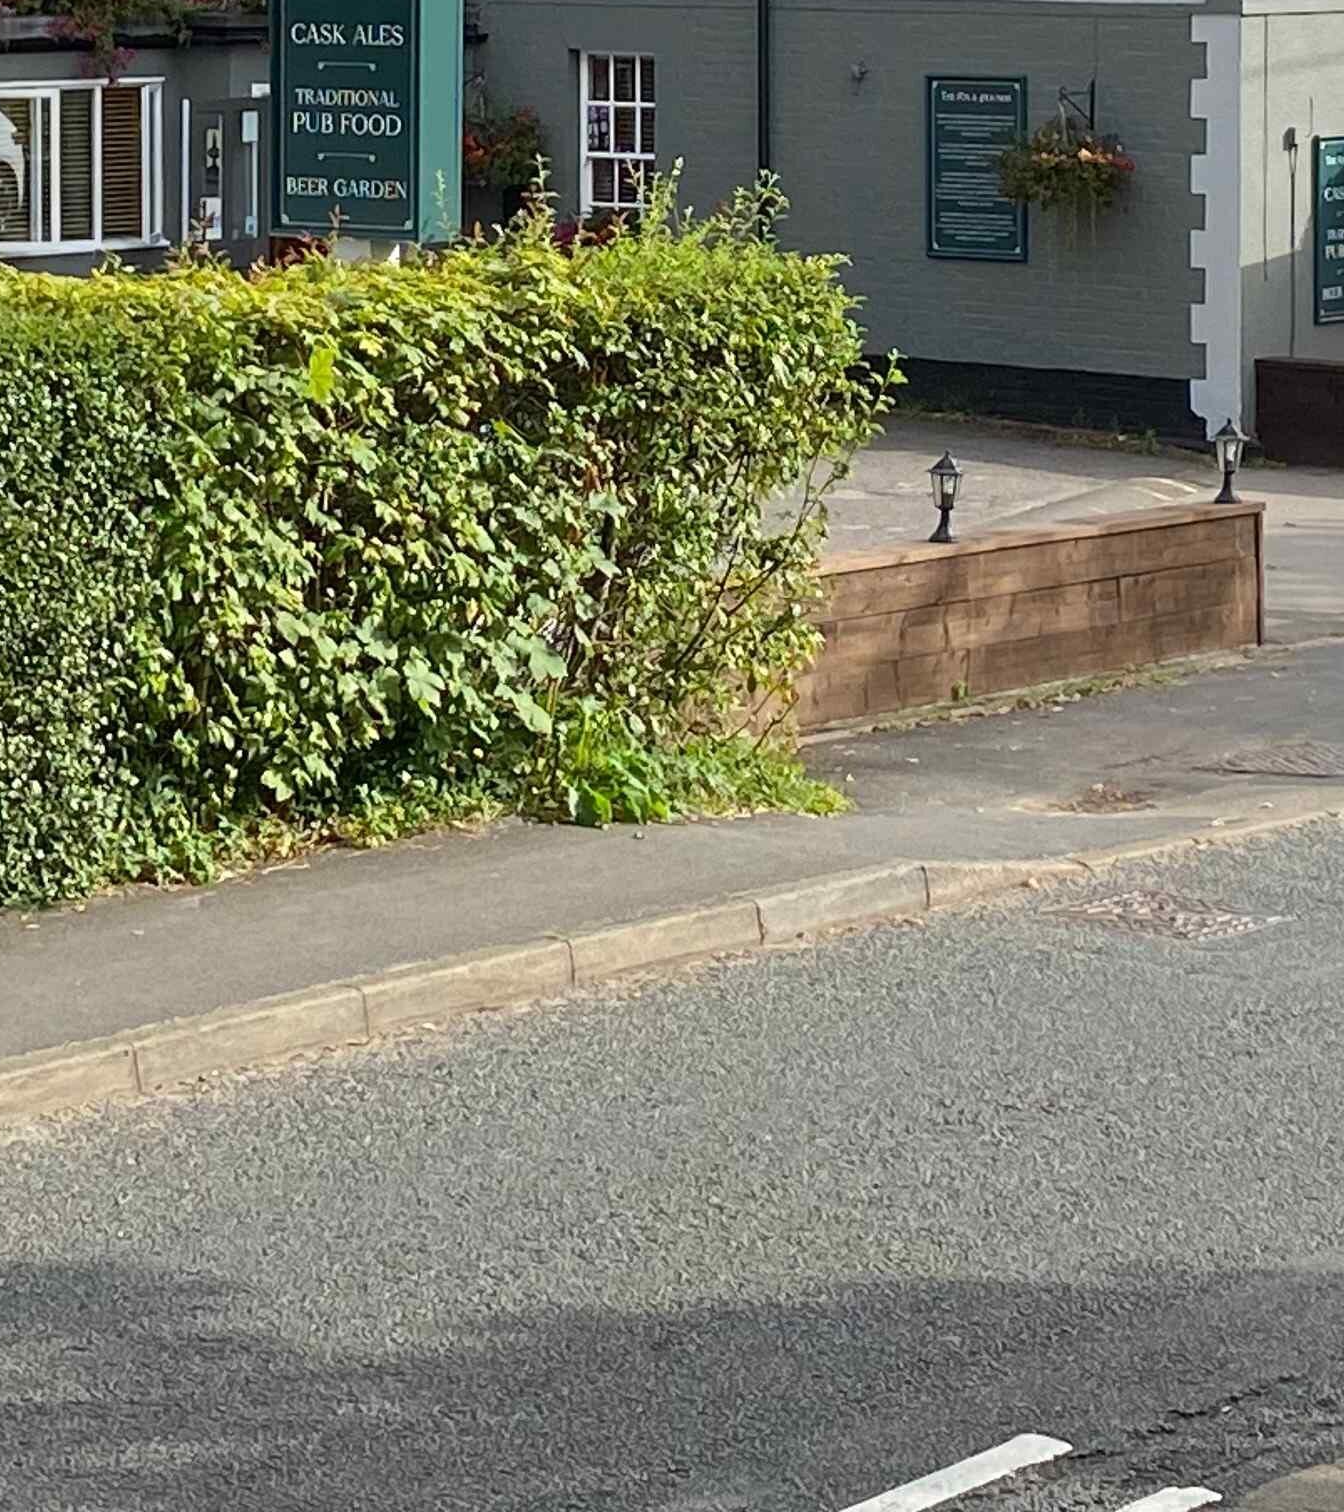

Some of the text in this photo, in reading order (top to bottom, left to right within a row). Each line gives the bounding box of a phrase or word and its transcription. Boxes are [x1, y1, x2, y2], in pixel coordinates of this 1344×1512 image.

[291, 23, 404, 47] CASK ALES
[295, 88, 400, 108] TRADITIONAL
[293, 111, 402, 136] PUB FOOD
[286, 176, 406, 199] BEER GARDEN
